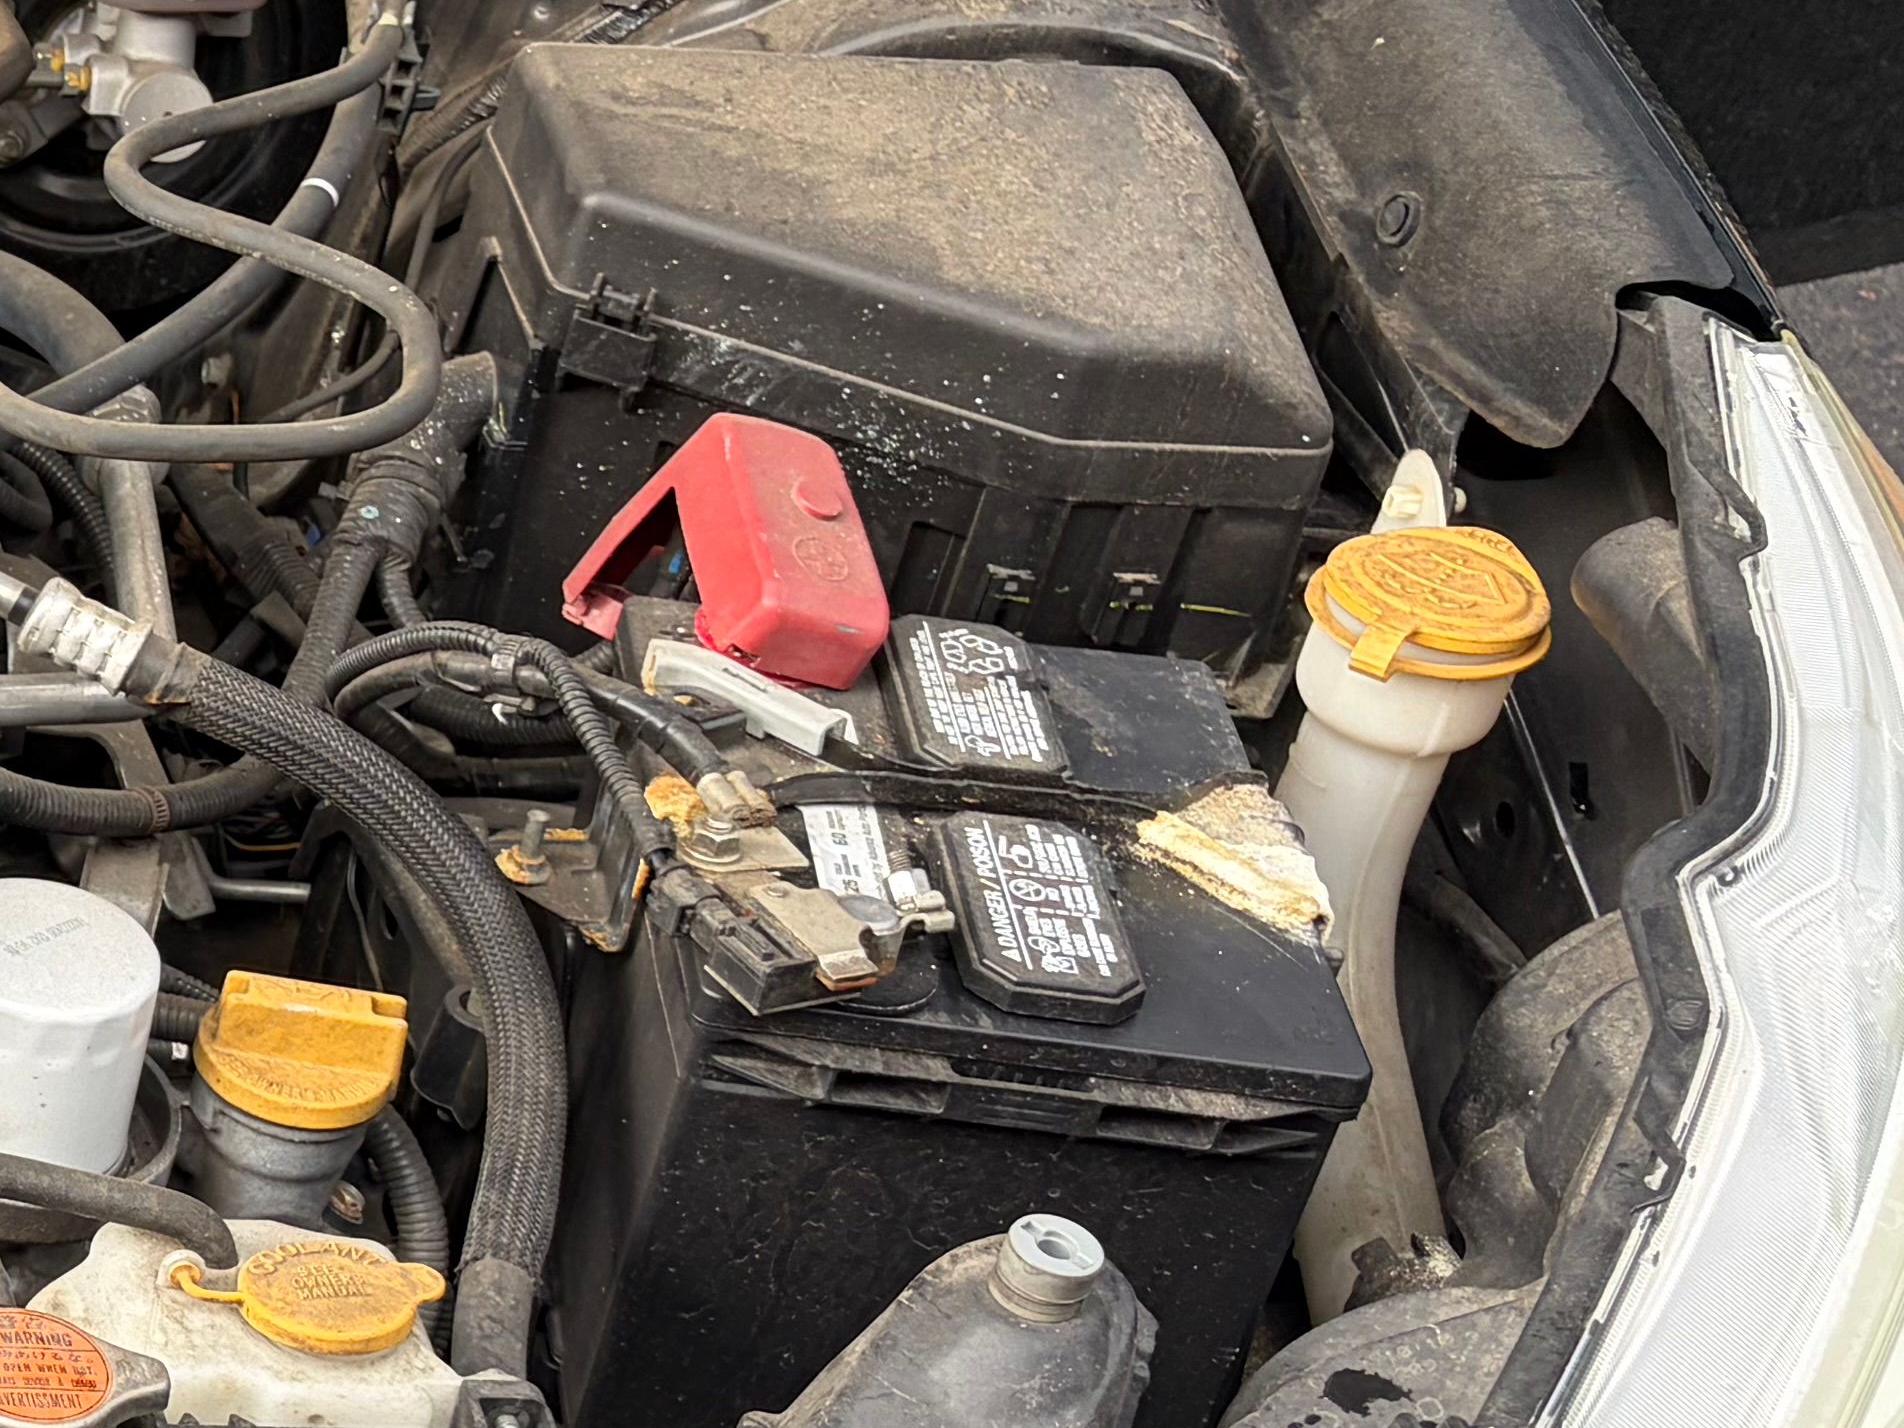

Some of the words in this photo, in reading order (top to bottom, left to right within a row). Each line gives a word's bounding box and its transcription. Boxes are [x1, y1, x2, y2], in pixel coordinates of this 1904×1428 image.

[964, 826, 997, 879] POISON
[983, 889, 1018, 949] DANGER
[247, 1240, 388, 1276] COOLANT
[296, 1263, 335, 1277] SEE
[296, 1284, 371, 1301] MANUAL
[0, 1329, 73, 1347] WARNING
[3, 1362, 32, 1373] OPEN
[36, 1363, 68, 1374] WHEN
